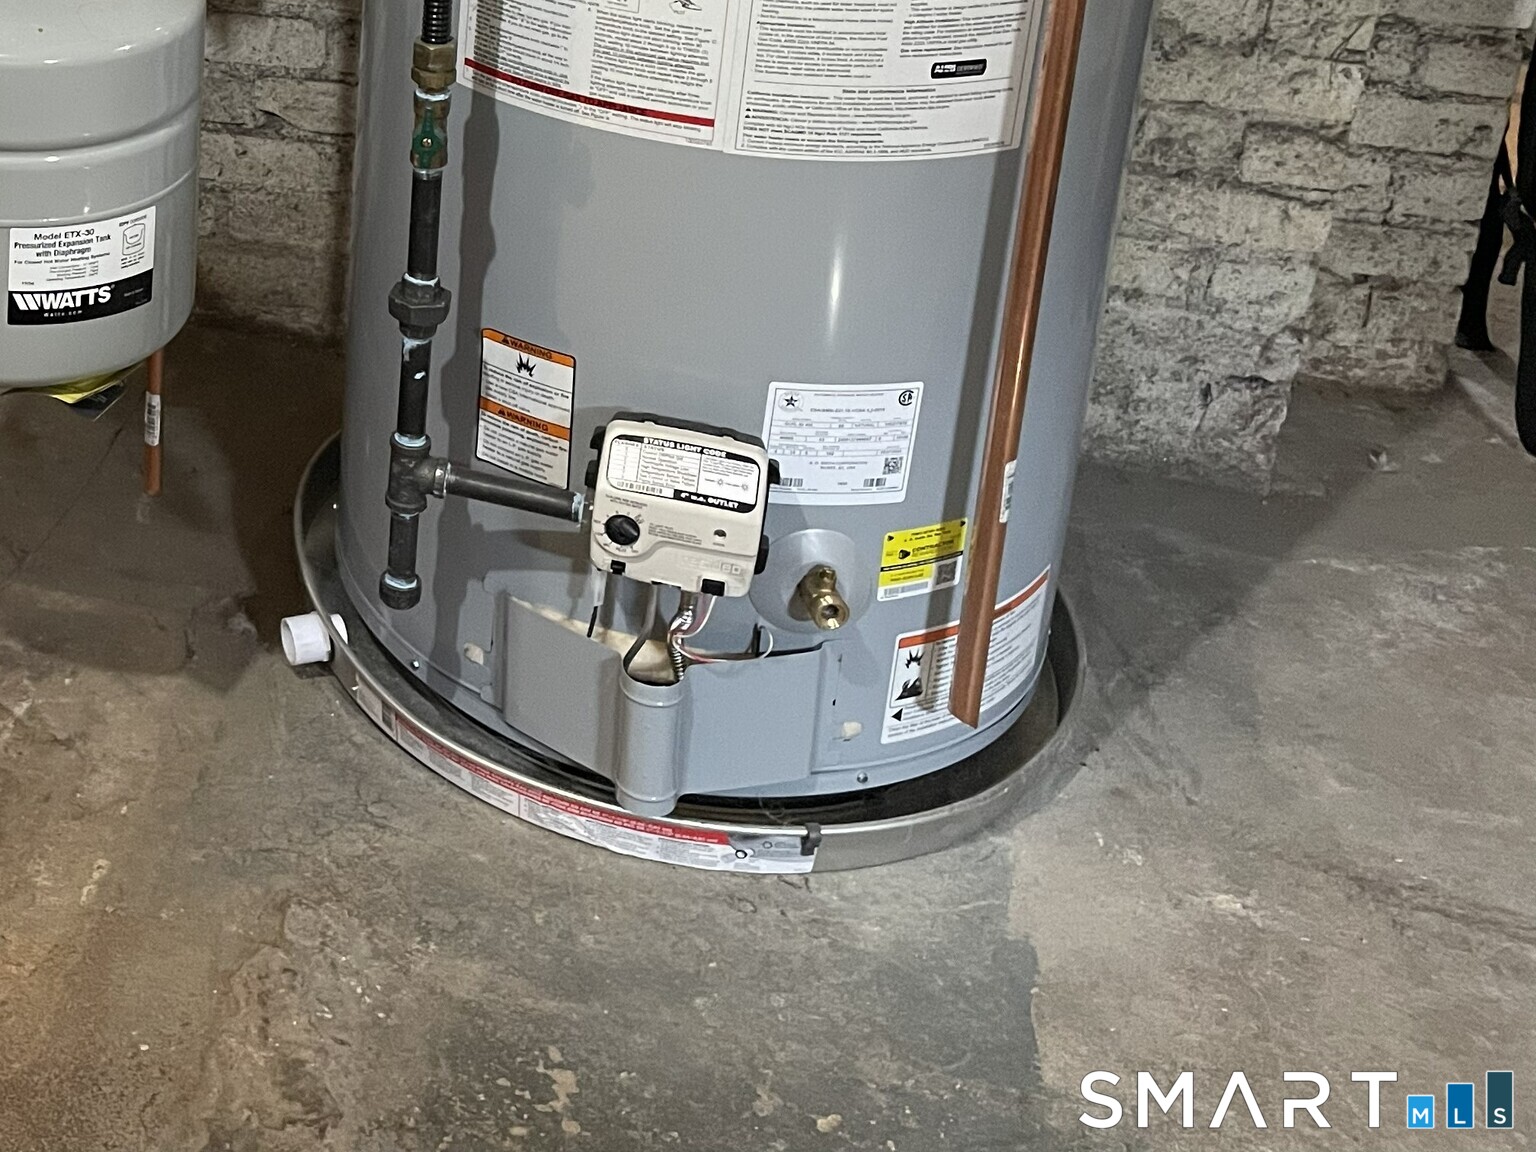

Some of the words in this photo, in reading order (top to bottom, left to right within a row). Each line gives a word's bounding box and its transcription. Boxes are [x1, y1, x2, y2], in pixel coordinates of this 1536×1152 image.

[58, 238, 93, 248] Expansion
[96, 234, 111, 243] Tank
[64, 229, 94, 239] ETX-30
[54, 247, 91, 257] Diaphragm
[41, 285, 111, 310] WATTS
[510, 338, 552, 360] WARNING
[505, 408, 548, 432] WARNING
[644, 438, 675, 448] STATUS
[677, 443, 702, 452] LIGHT
[703, 448, 727, 458] CODE
[708, 497, 739, 508] OUTLET
